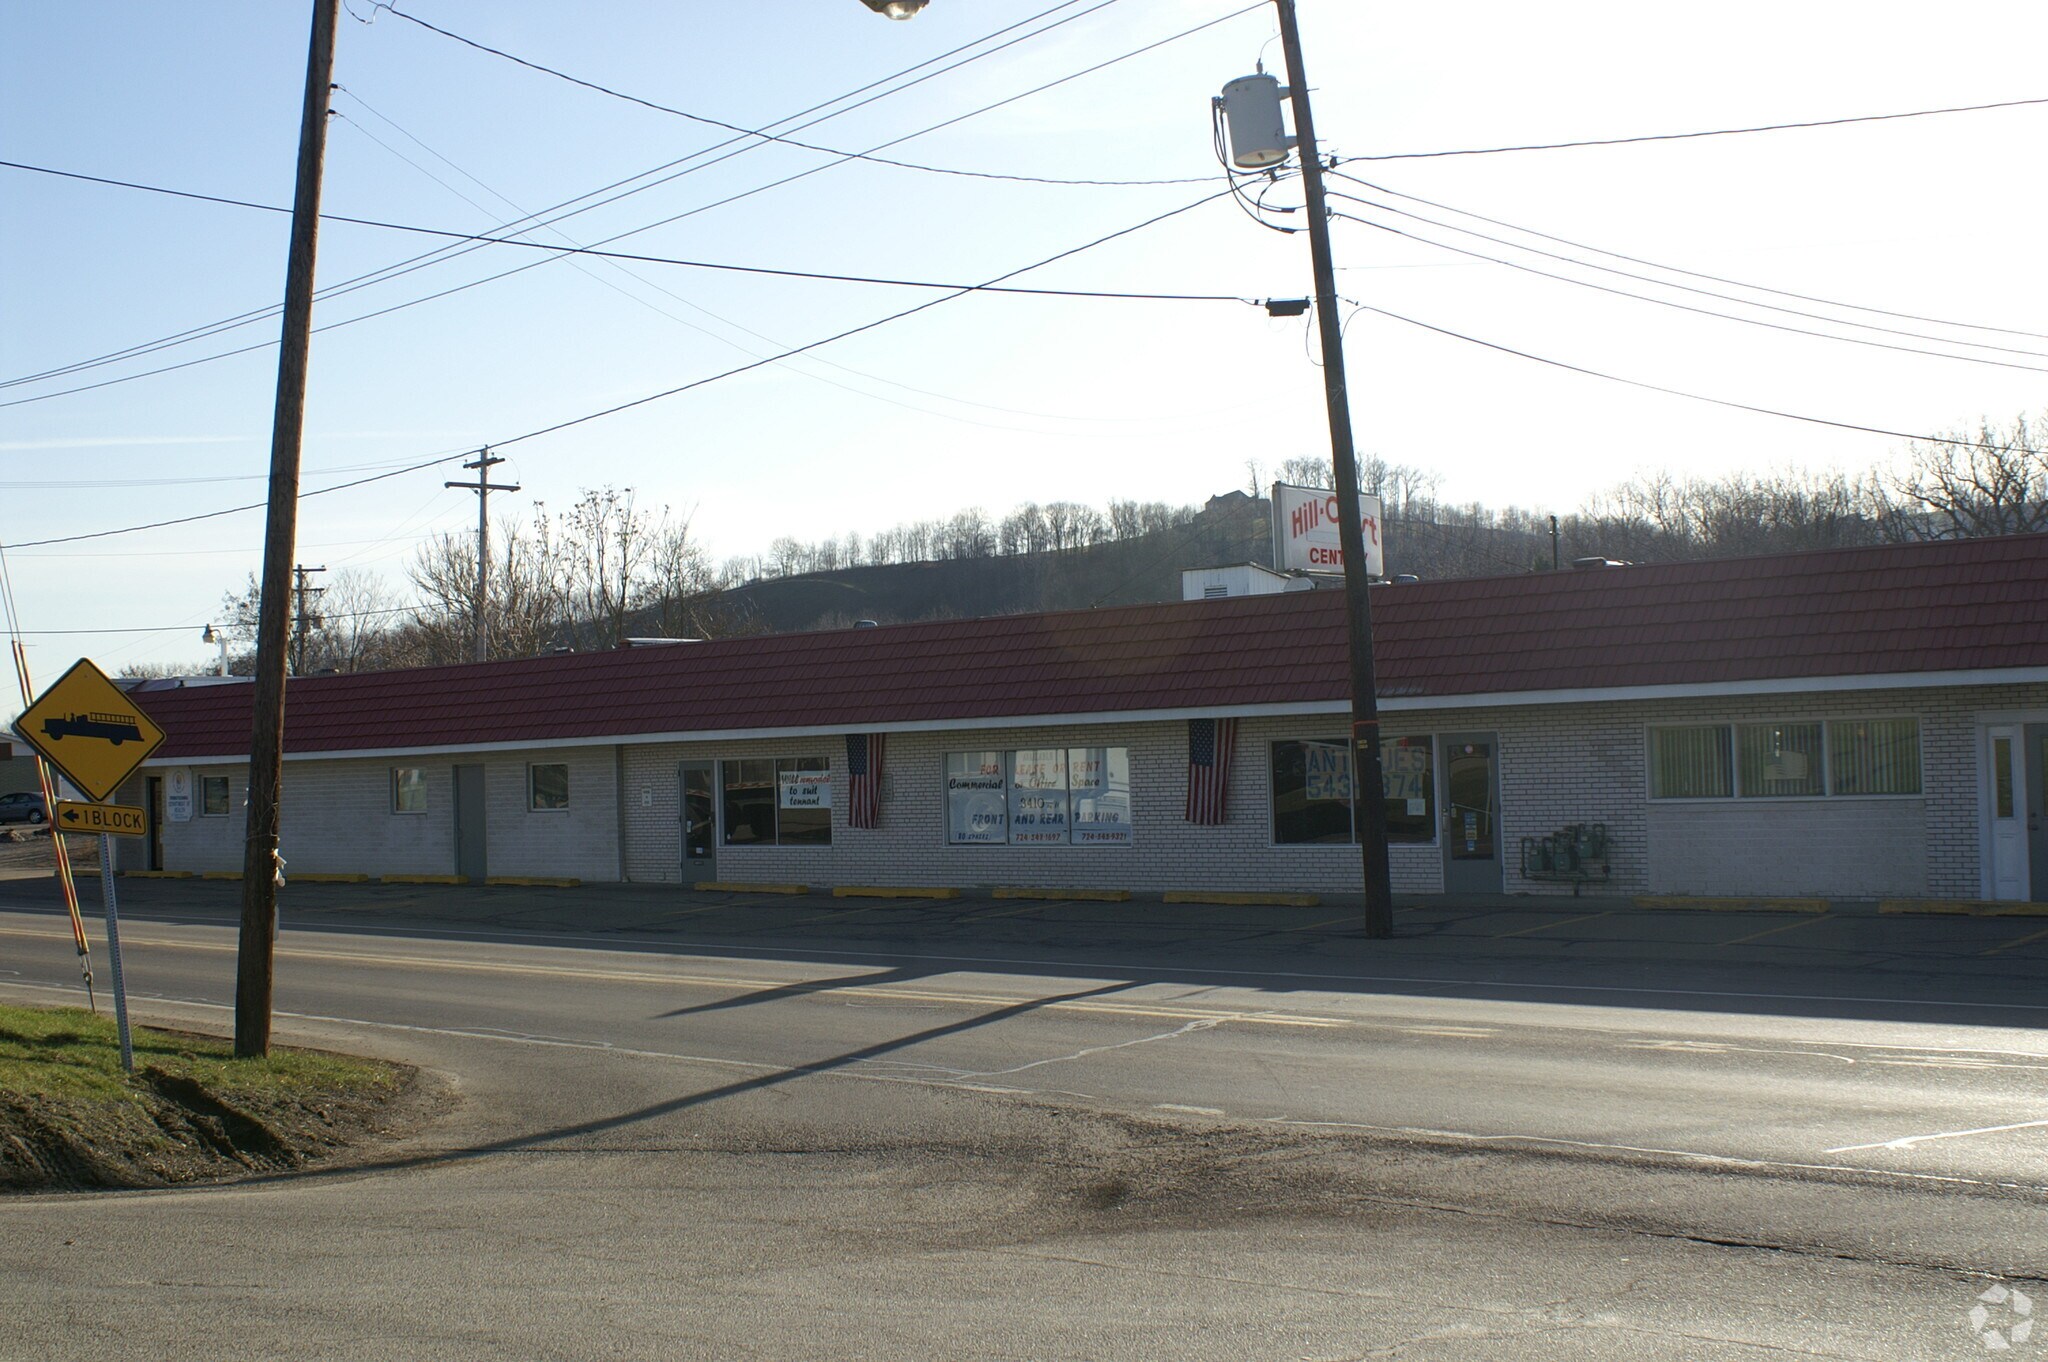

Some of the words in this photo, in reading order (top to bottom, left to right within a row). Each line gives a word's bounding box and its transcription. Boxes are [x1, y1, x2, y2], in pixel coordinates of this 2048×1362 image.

[1291, 495, 1378, 547] Hill-Crt
[1309, 547, 1368, 566] CENT
[980, 764, 999, 775] FOR
[1072, 761, 1101, 773] RENT
[1307, 746, 1425, 774] ANTUES
[789, 786, 798, 795] to
[802, 785, 818, 795] suit
[949, 778, 1004, 790] Commercial
[1071, 774, 1100, 788] Space
[1307, 773, 1423, 799] 543-74
[83, 810, 88, 824] 1
[92, 811, 142, 829] BLOCK
[972, 814, 1004, 825] FRONT
[1014, 813, 1035, 825] AND
[1039, 813, 1064, 825] REAR
[1074, 812, 1119, 825] PARKING
